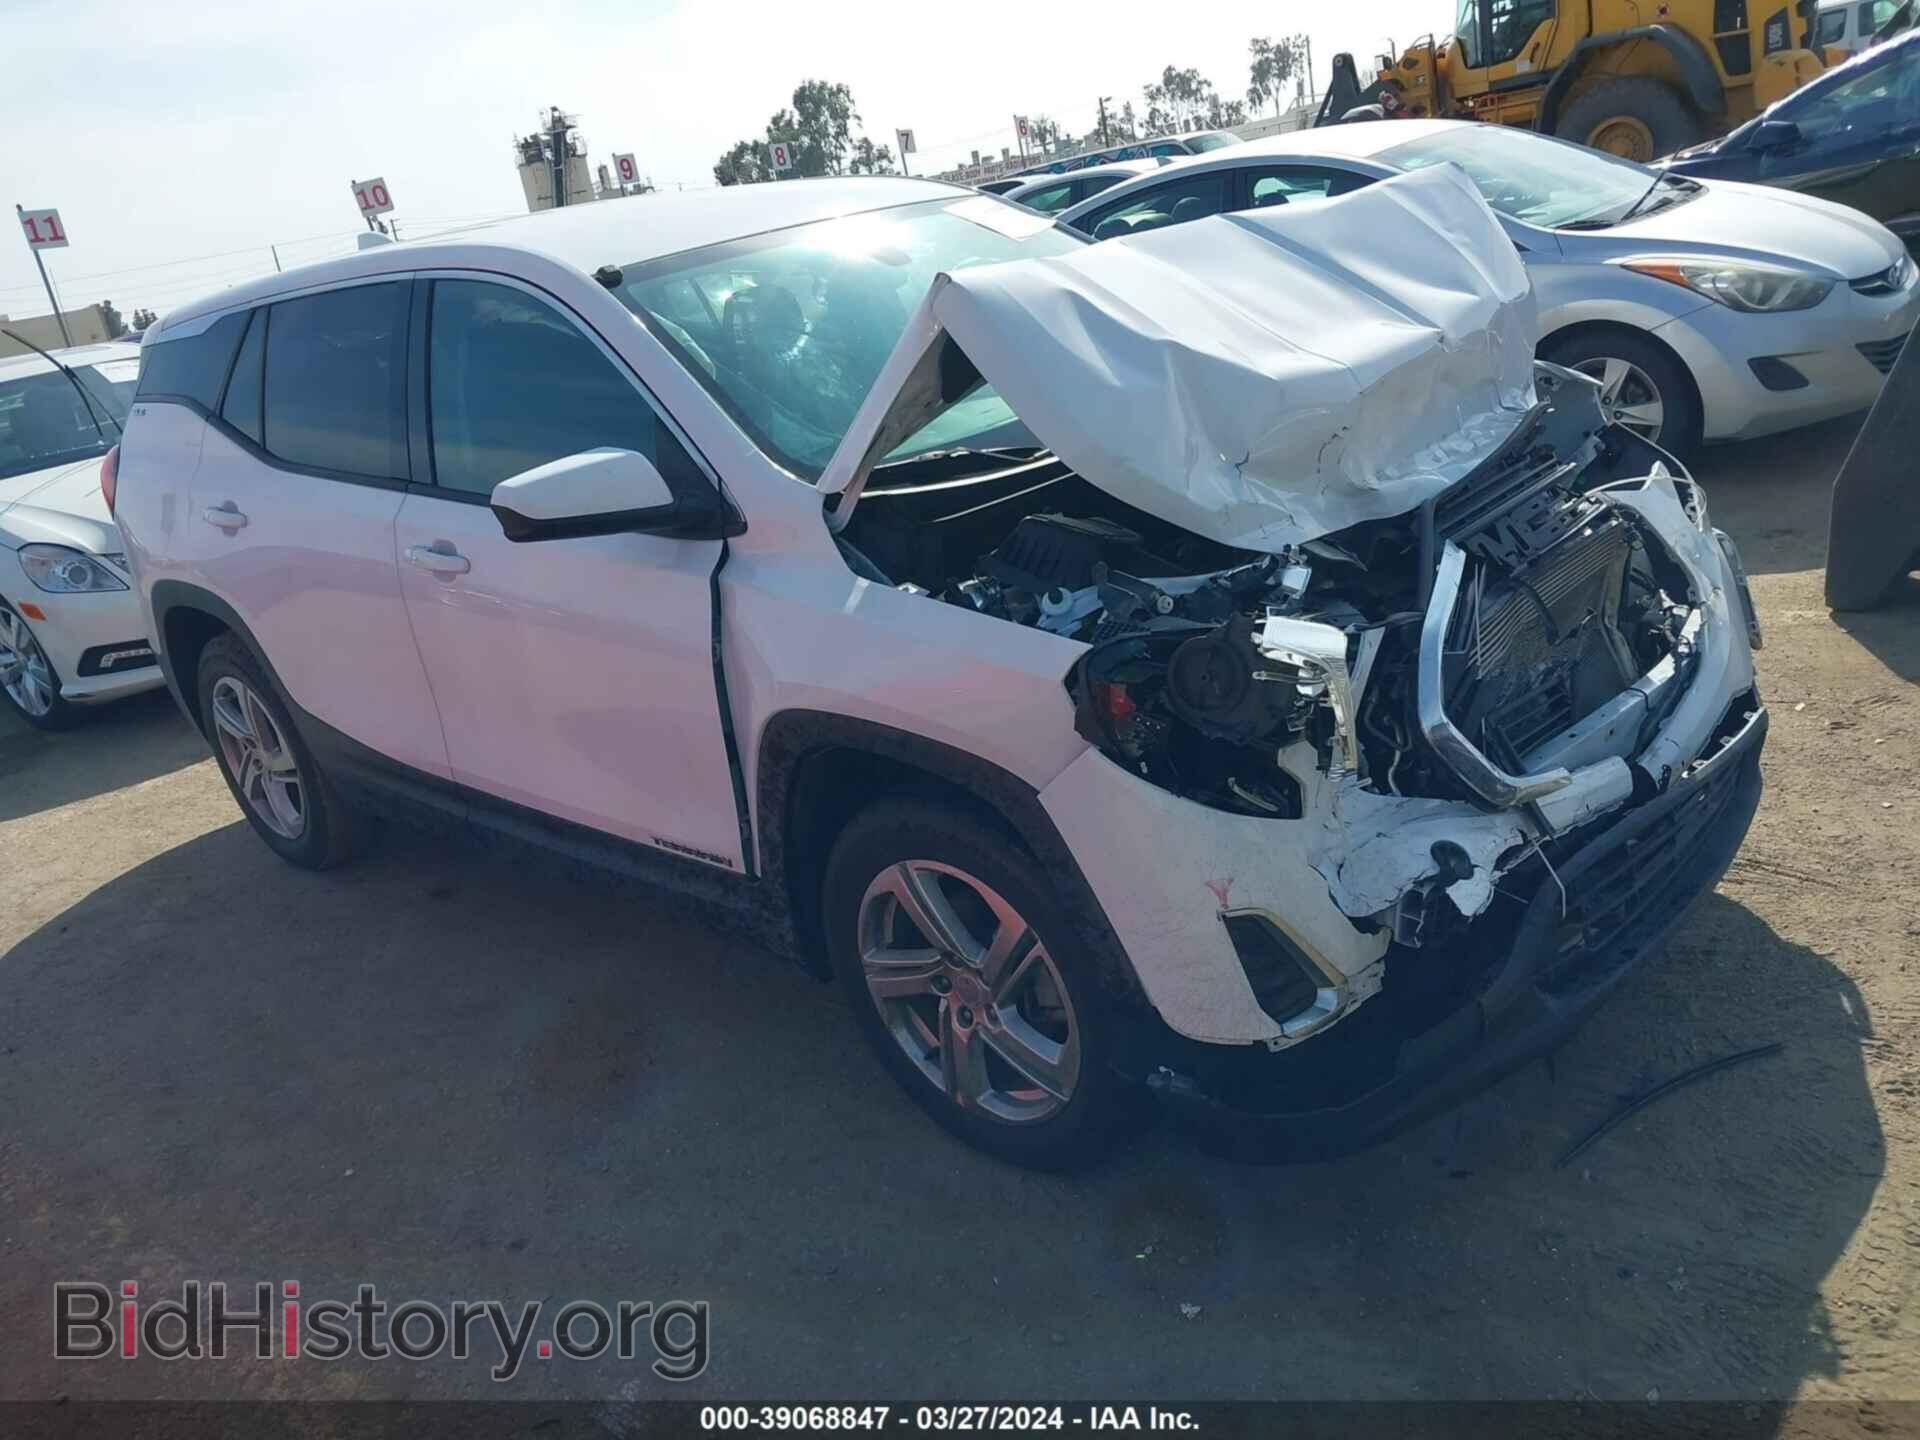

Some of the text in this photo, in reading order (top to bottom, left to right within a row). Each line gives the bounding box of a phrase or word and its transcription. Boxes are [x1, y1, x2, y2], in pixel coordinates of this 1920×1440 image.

[1018, 119, 1028, 136] 6
[900, 132, 910, 151] 7
[774, 146, 786, 166] 8
[619, 158, 633, 180] 9
[355, 184, 389, 210] 10
[22, 215, 65, 243] 11
